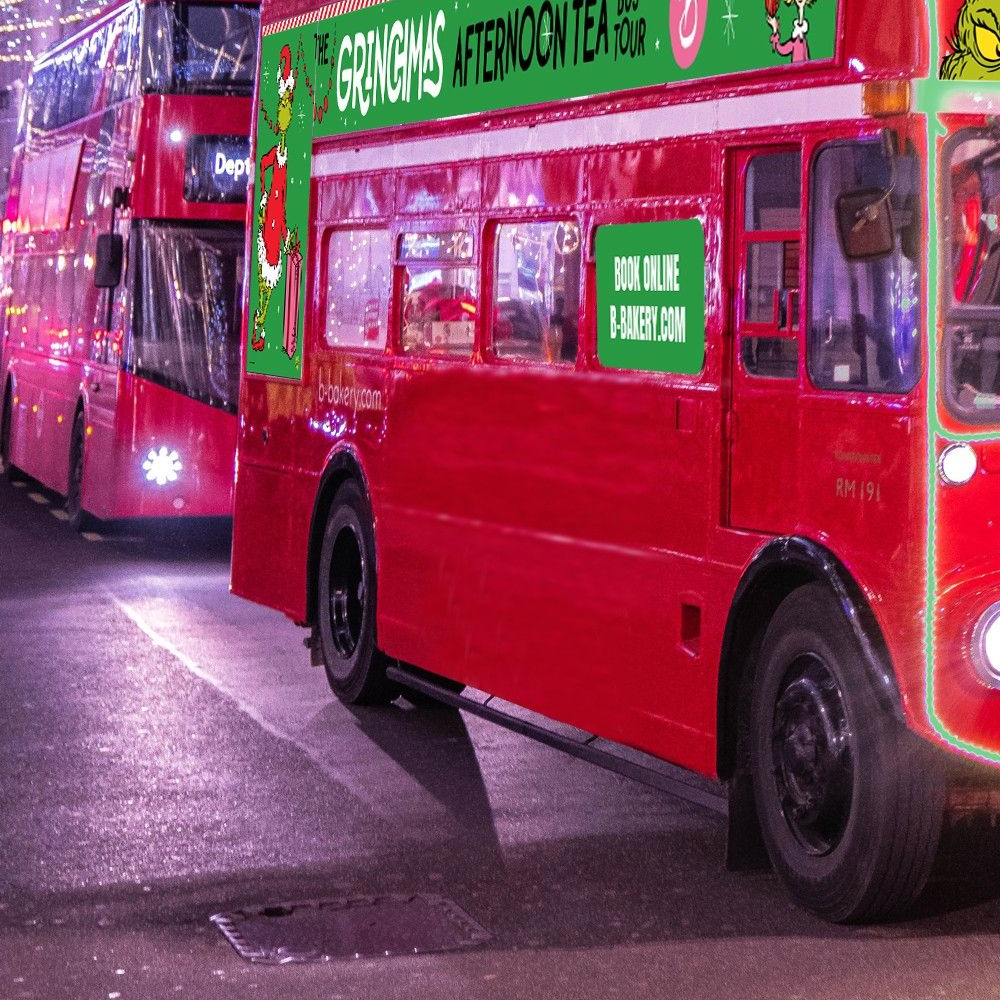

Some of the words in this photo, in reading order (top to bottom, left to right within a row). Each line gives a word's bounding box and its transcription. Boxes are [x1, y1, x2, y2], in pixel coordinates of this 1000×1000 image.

[314, 32, 329, 66] THE
[336, 9, 446, 117] GRINCHMAS
[452, 0, 568, 88] AFTERNOON
[614, 17, 646, 61] TOUR
[614, 255, 641, 292] BOOK
[643, 253, 680, 292] ONLINE
[610, 304, 686, 343] B-BAKERY.COM
[318, 370, 382, 418] b-bakery.com
[836, 477, 856, 498] RM
[860, 481, 880, 502] 191
